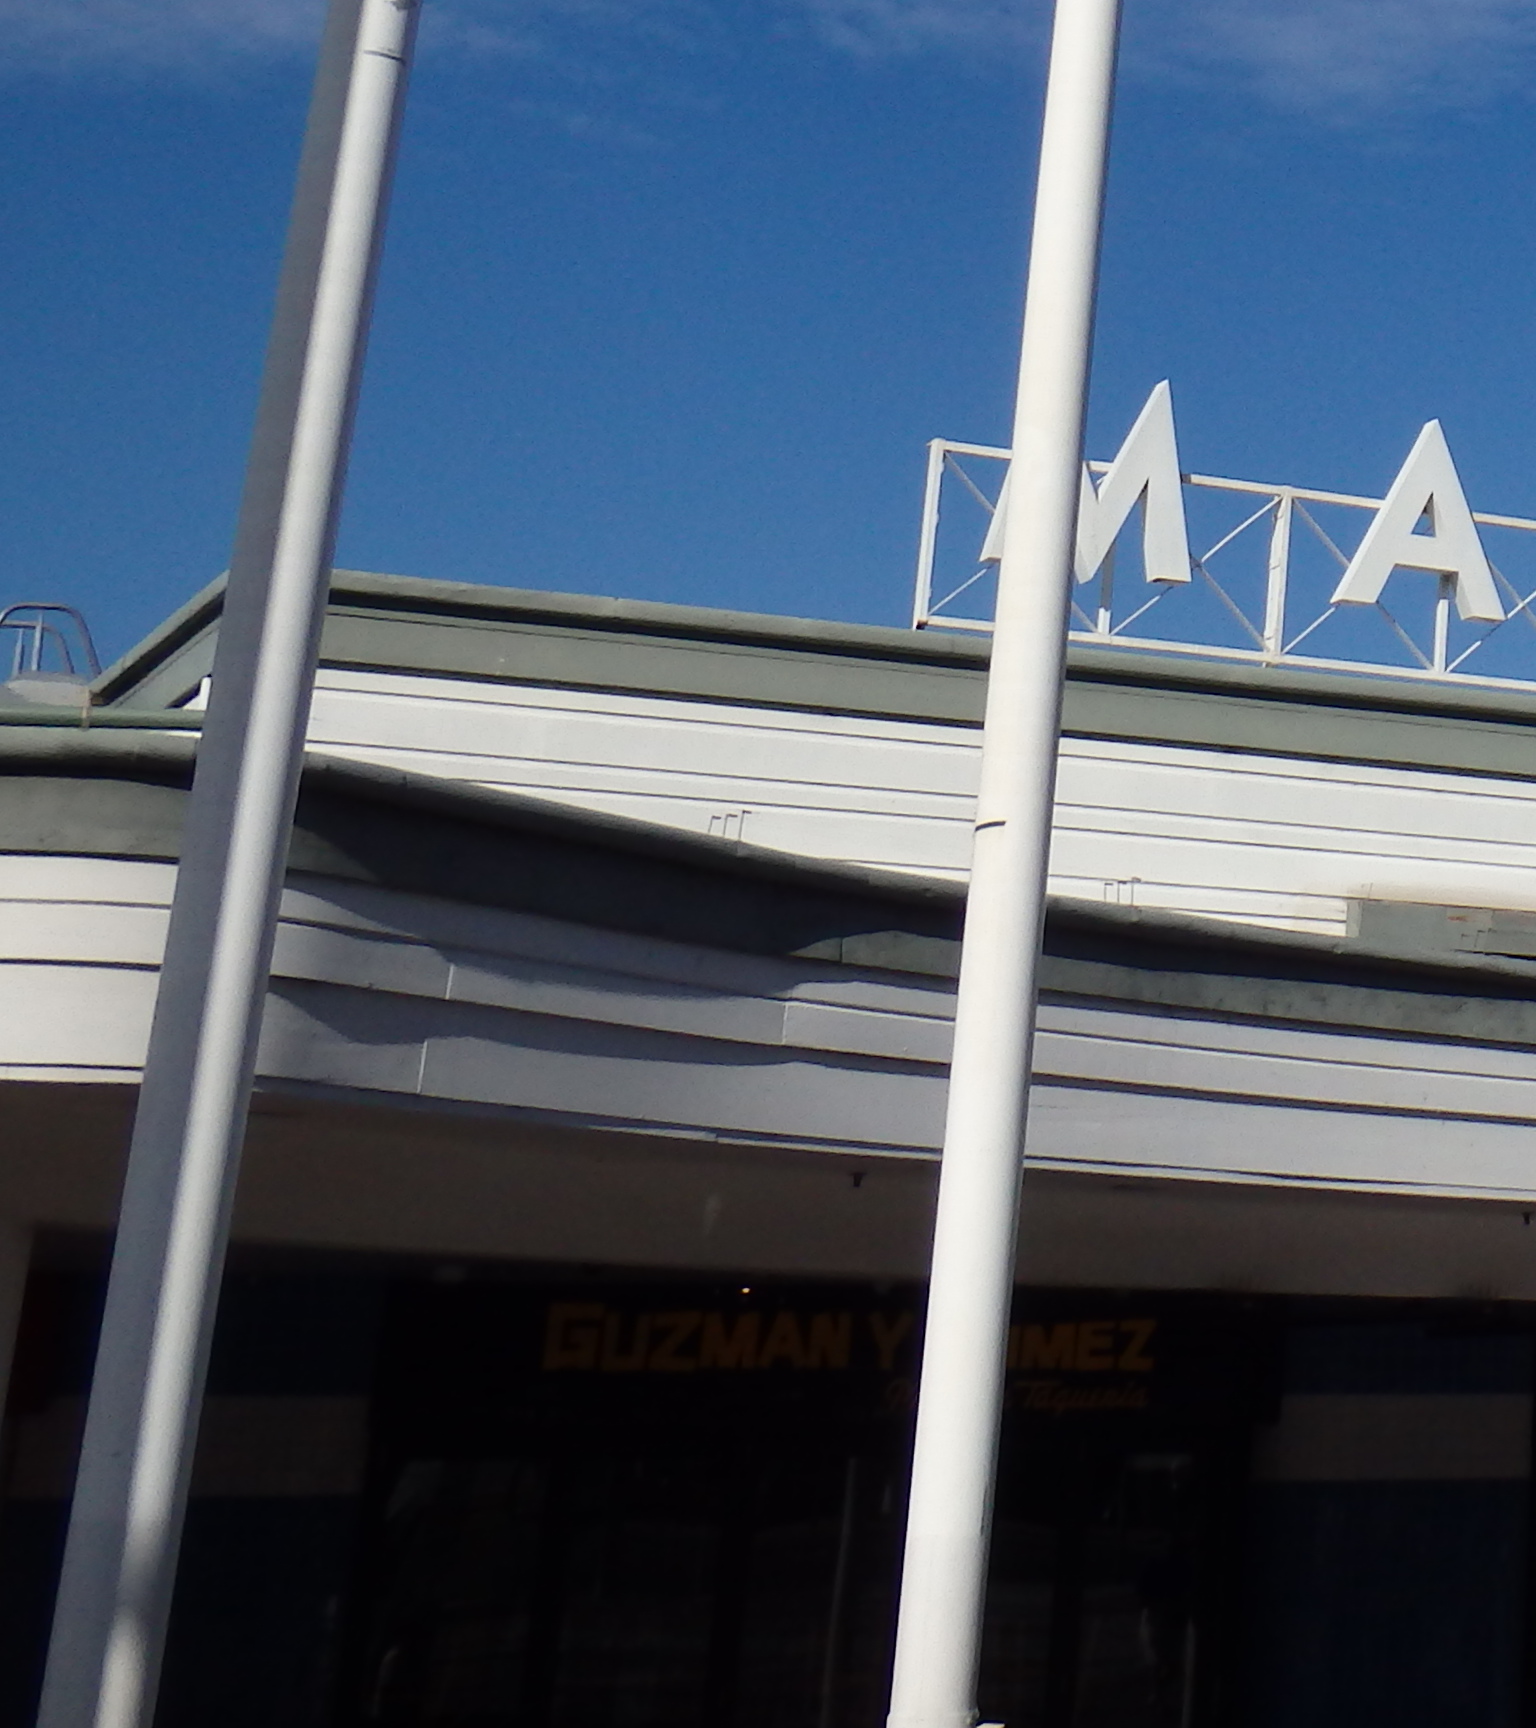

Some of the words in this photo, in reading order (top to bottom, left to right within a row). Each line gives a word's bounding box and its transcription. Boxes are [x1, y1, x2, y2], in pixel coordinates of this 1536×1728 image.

[541, 1300, 856, 1374] GUZMAN
[867, 1309, 914, 1372] Y
[1008, 1318, 1158, 1374] MEZ
